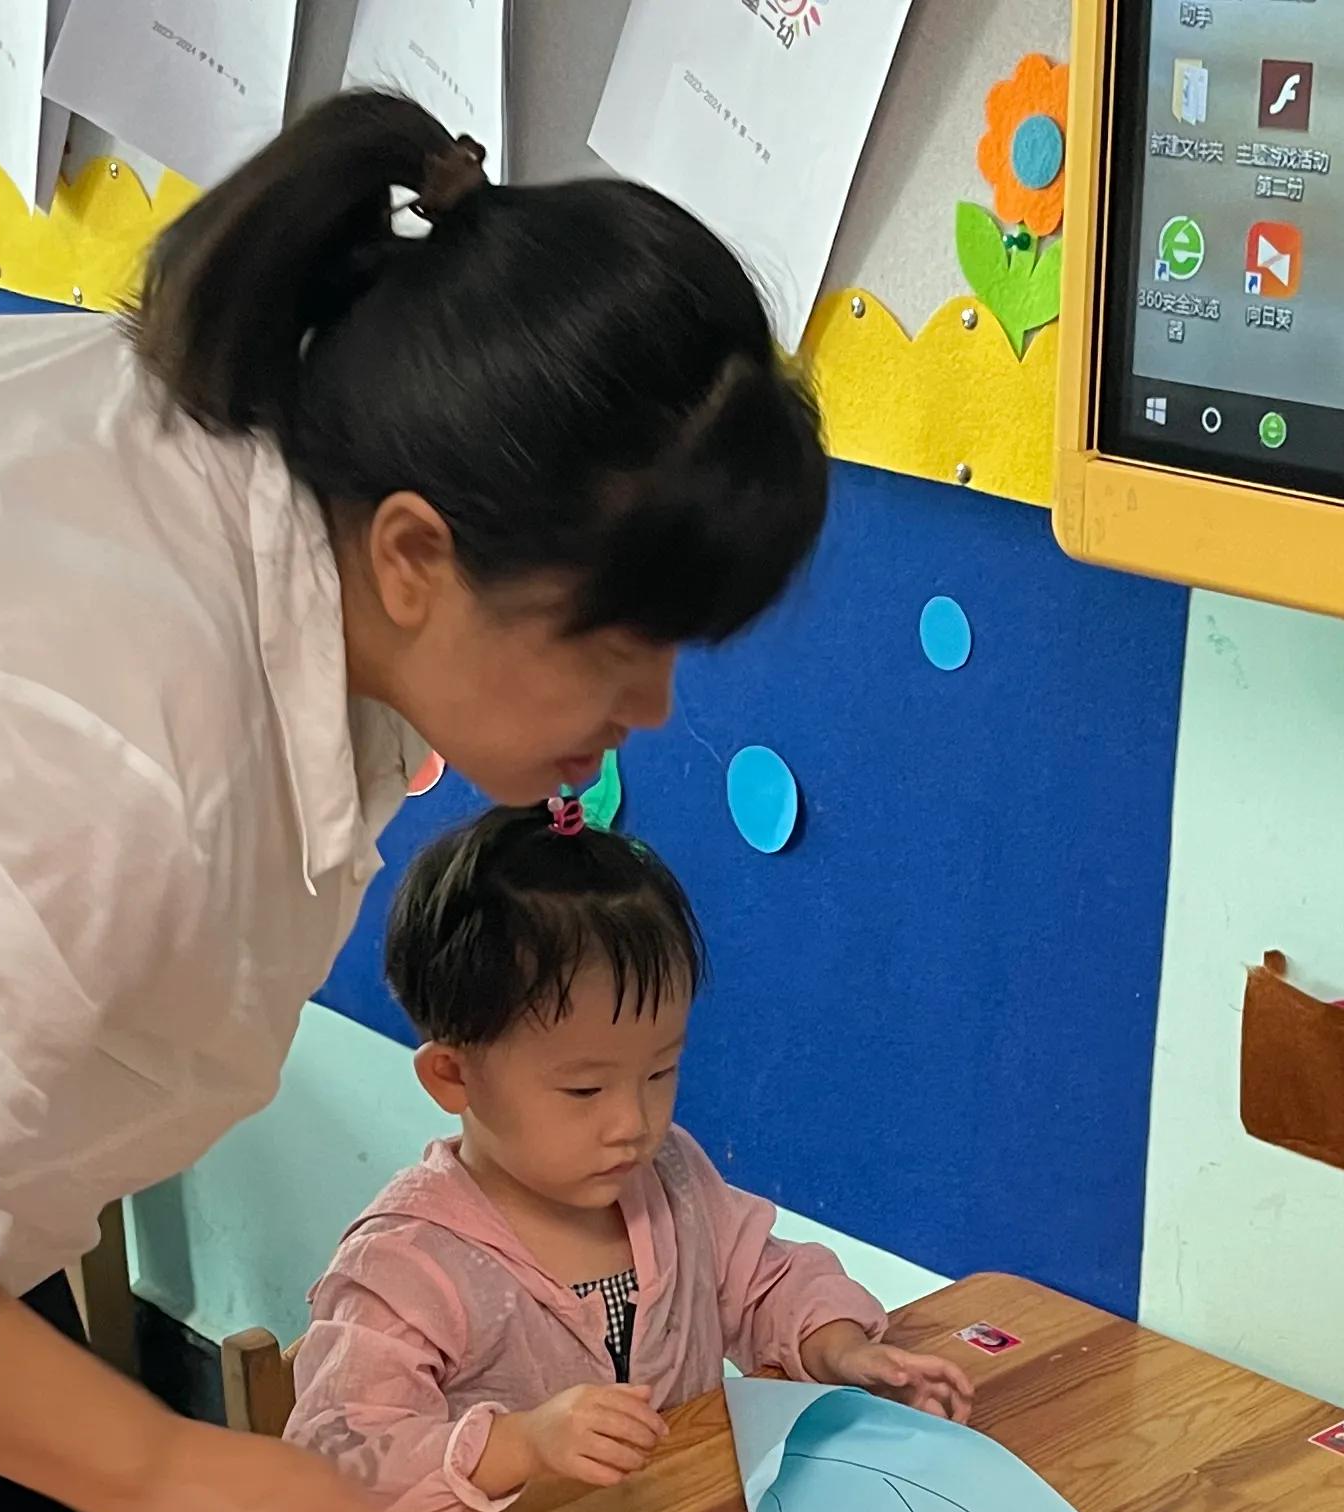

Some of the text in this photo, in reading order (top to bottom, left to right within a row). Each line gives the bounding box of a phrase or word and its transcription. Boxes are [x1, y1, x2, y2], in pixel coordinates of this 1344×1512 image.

[1150, 132, 1224, 163] 新建文件夹
[1236, 142, 1332, 175] 主题游戏活动
[1256, 174, 1305, 202] 第二册
[1138, 287, 1222, 321] 360安全浏览
[1245, 304, 1295, 333] 向日葵
